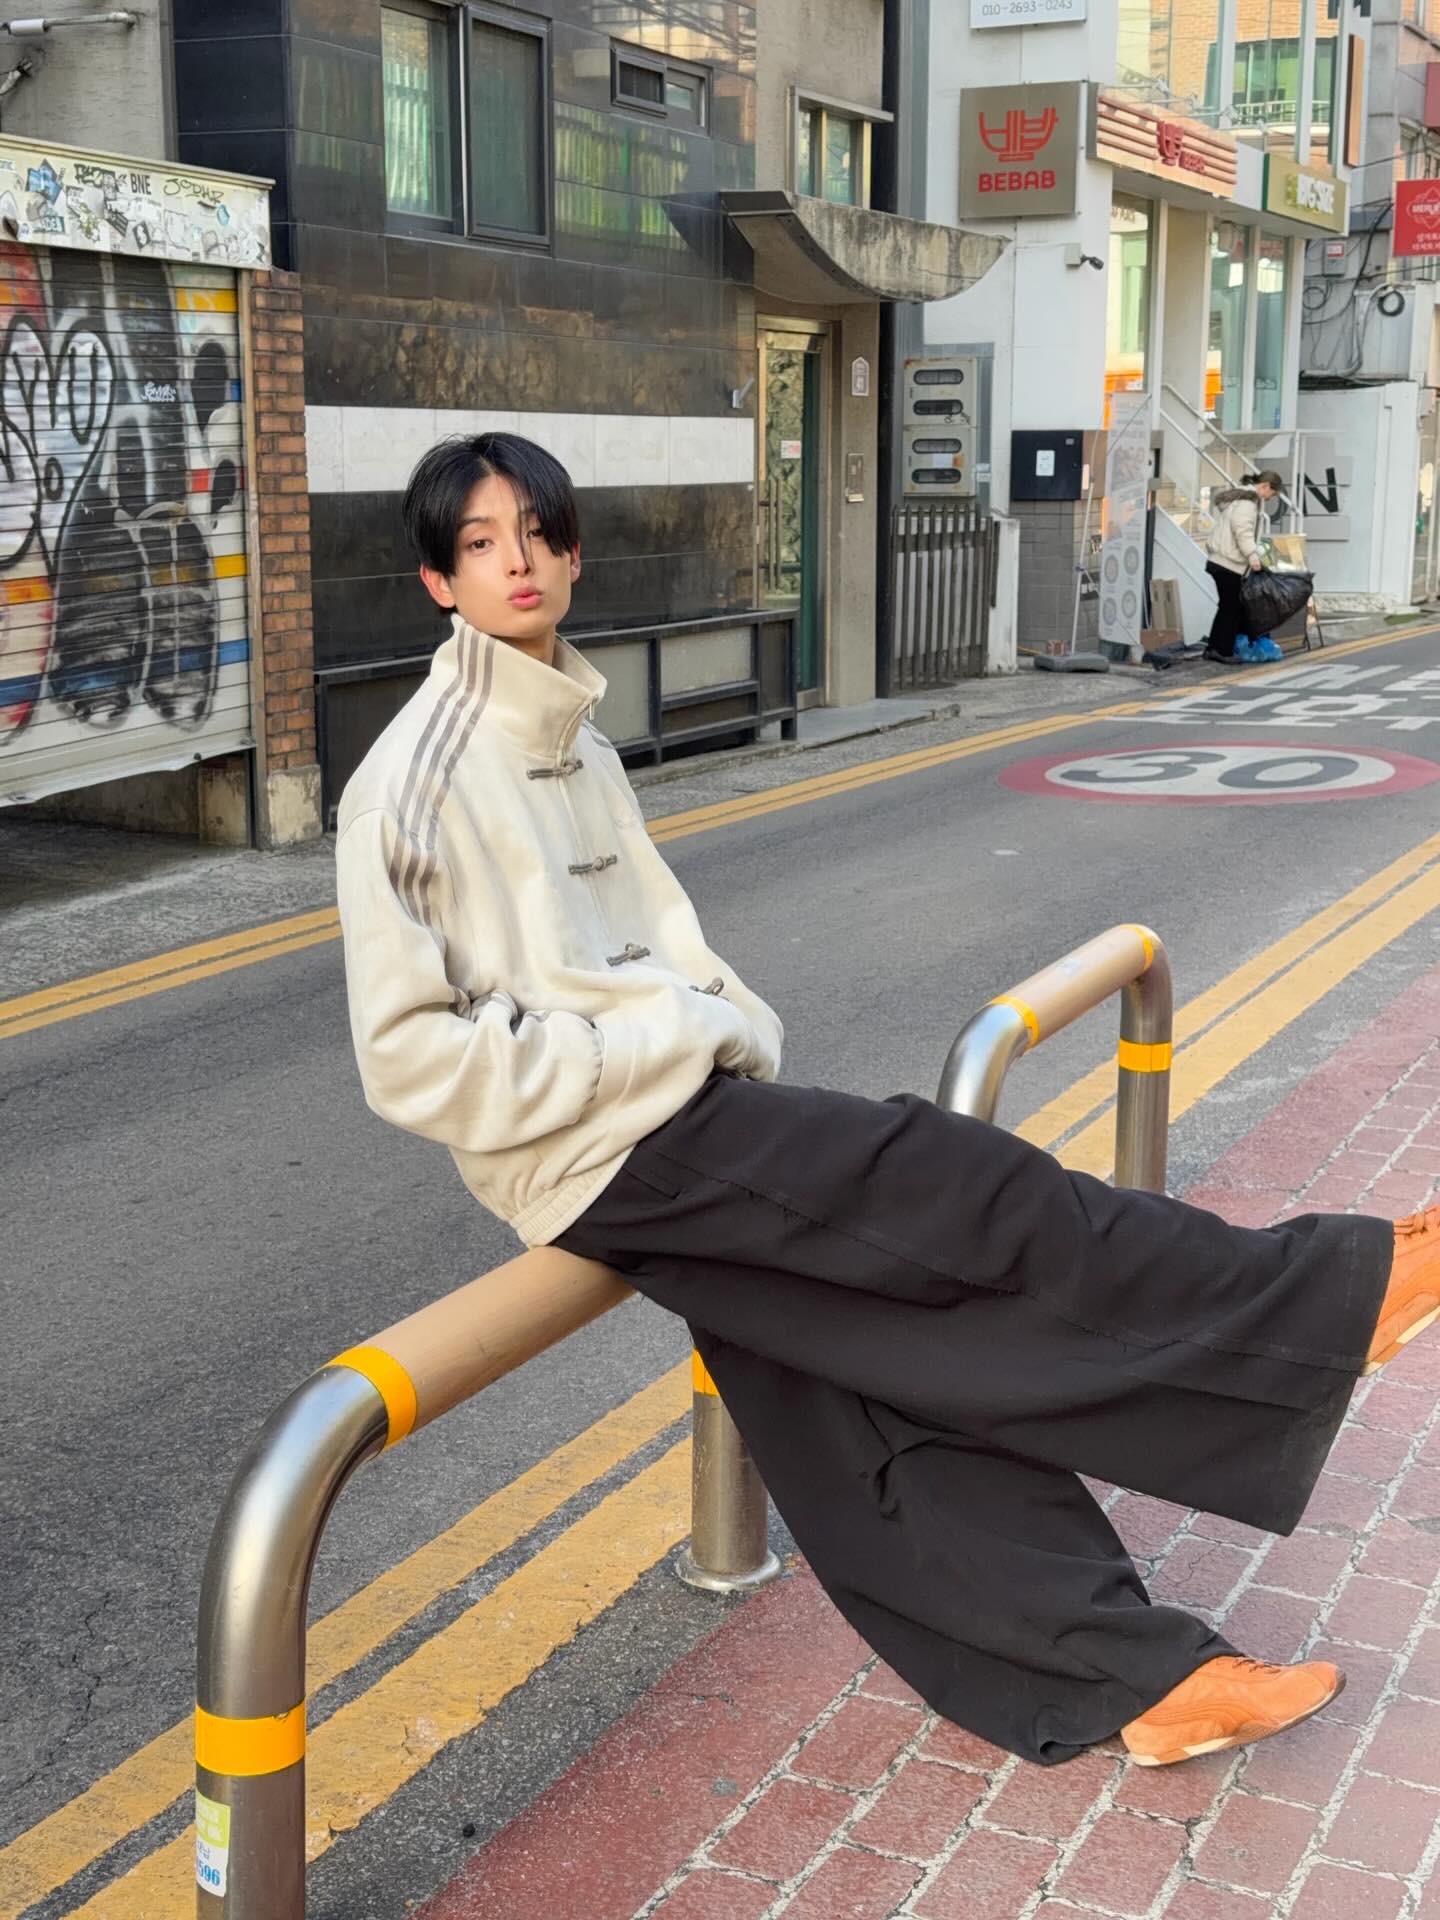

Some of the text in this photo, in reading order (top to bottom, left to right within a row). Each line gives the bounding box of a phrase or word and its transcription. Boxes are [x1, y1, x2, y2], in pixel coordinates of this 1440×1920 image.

[130, 173, 151, 195] BNE
[978, 170, 1056, 192] BEBAB
[1060, 751, 1359, 789] 30
[196, 1856, 220, 1886] 596
